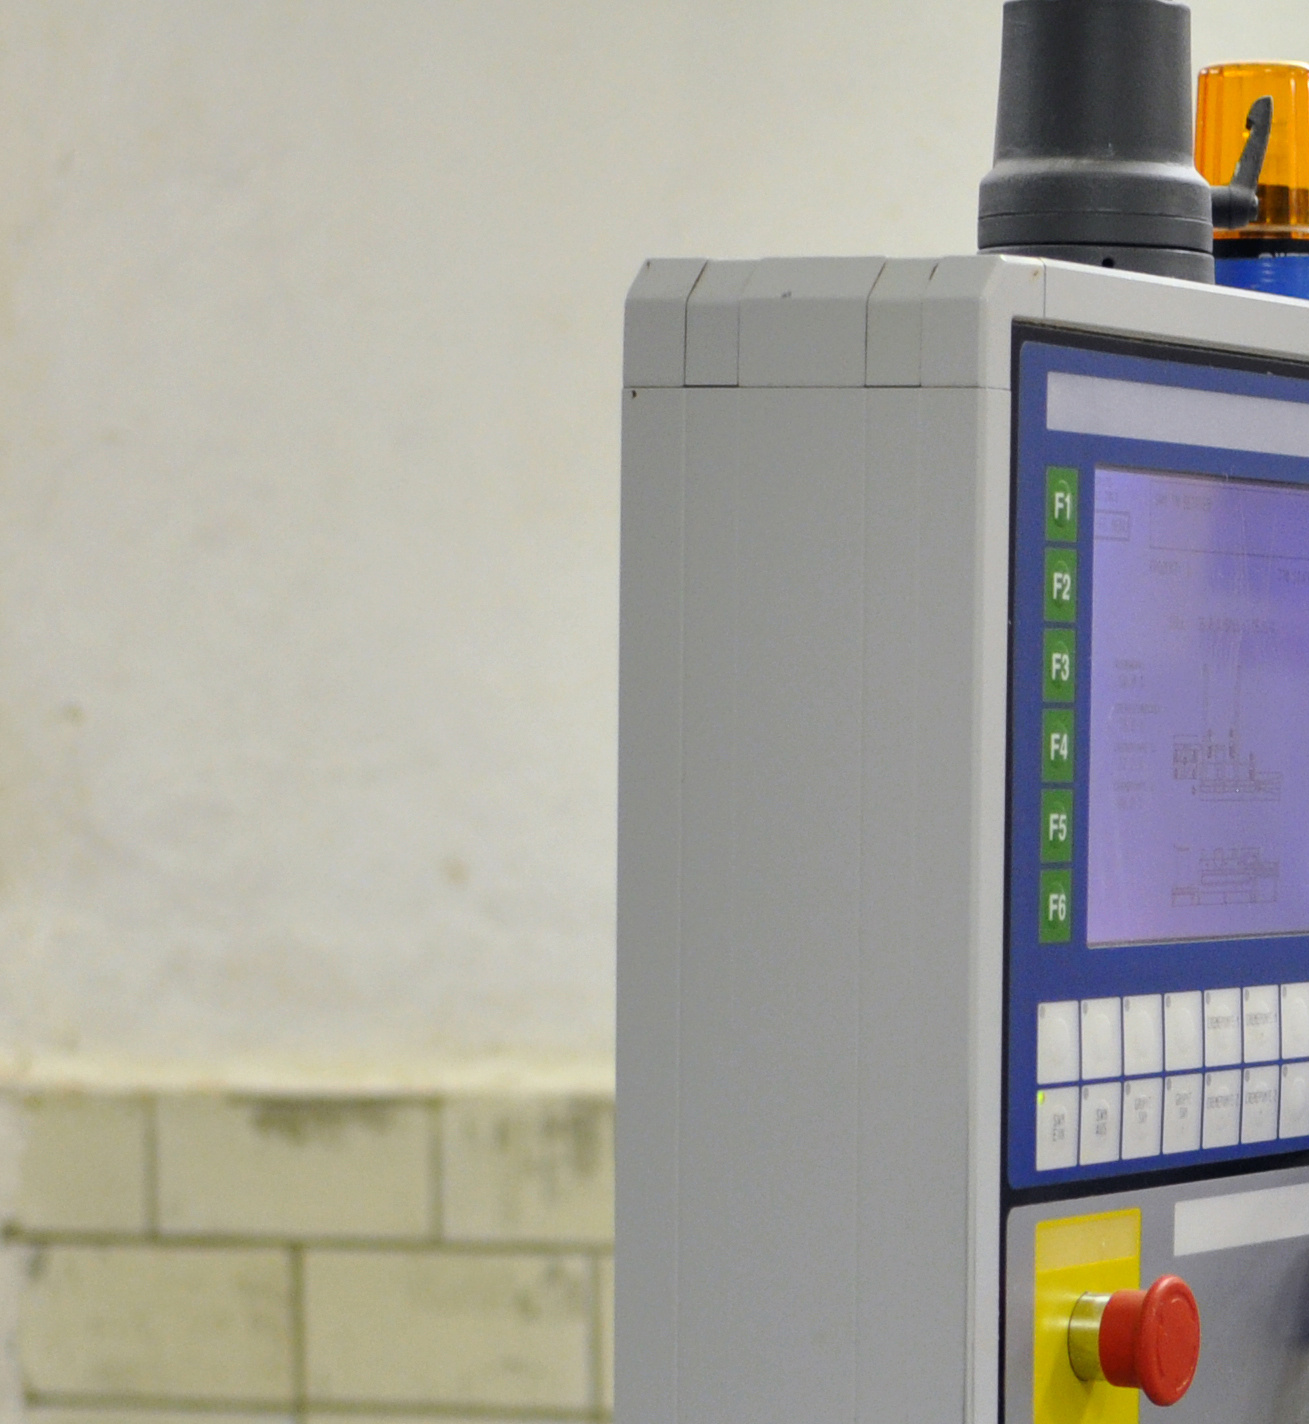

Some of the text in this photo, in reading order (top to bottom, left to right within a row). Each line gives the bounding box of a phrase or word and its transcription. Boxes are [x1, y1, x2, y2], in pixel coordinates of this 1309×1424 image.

[1054, 493, 1072, 520] F1
[1053, 573, 1072, 601] F2
[1051, 653, 1070, 681] F3
[1050, 734, 1069, 760] F4
[1049, 814, 1068, 841] F5
[1049, 894, 1067, 921] F6
